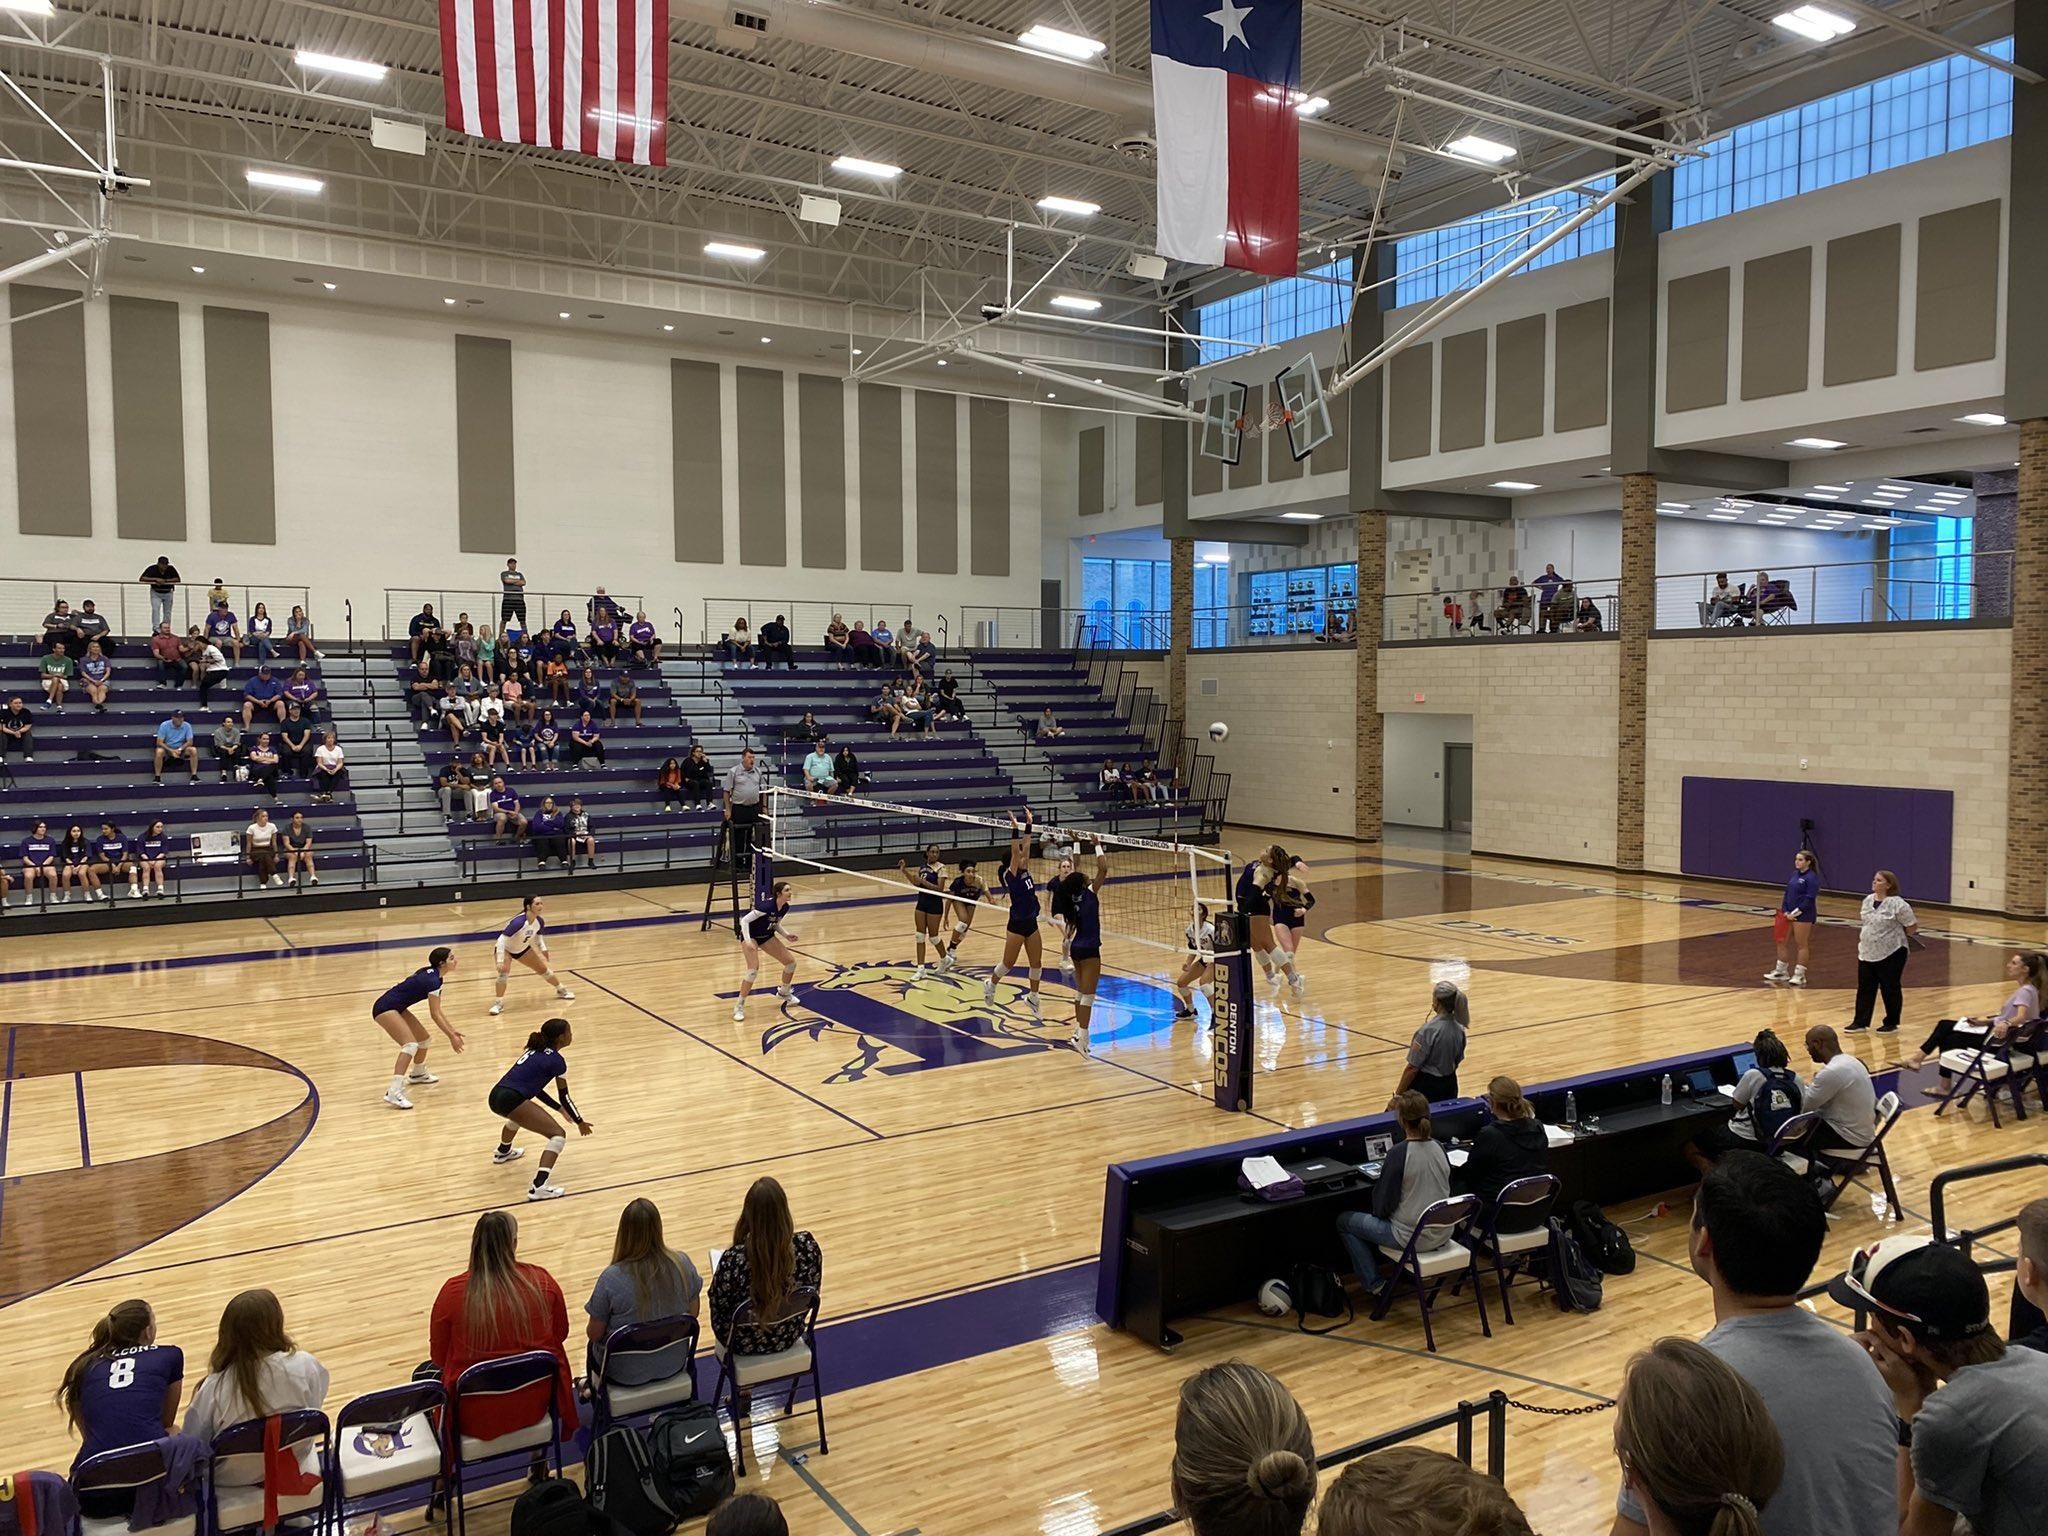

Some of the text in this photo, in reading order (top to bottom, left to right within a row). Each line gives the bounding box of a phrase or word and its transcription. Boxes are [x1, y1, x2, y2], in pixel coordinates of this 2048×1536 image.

[1043, 826, 1063, 835] DENTON
[1116, 836, 1170, 850] DENTON BRONCOS
[1214, 963, 1229, 1088] BRONCOS
[1229, 1002, 1238, 1055] DENTON
[108, 1357, 136, 1389] 8
